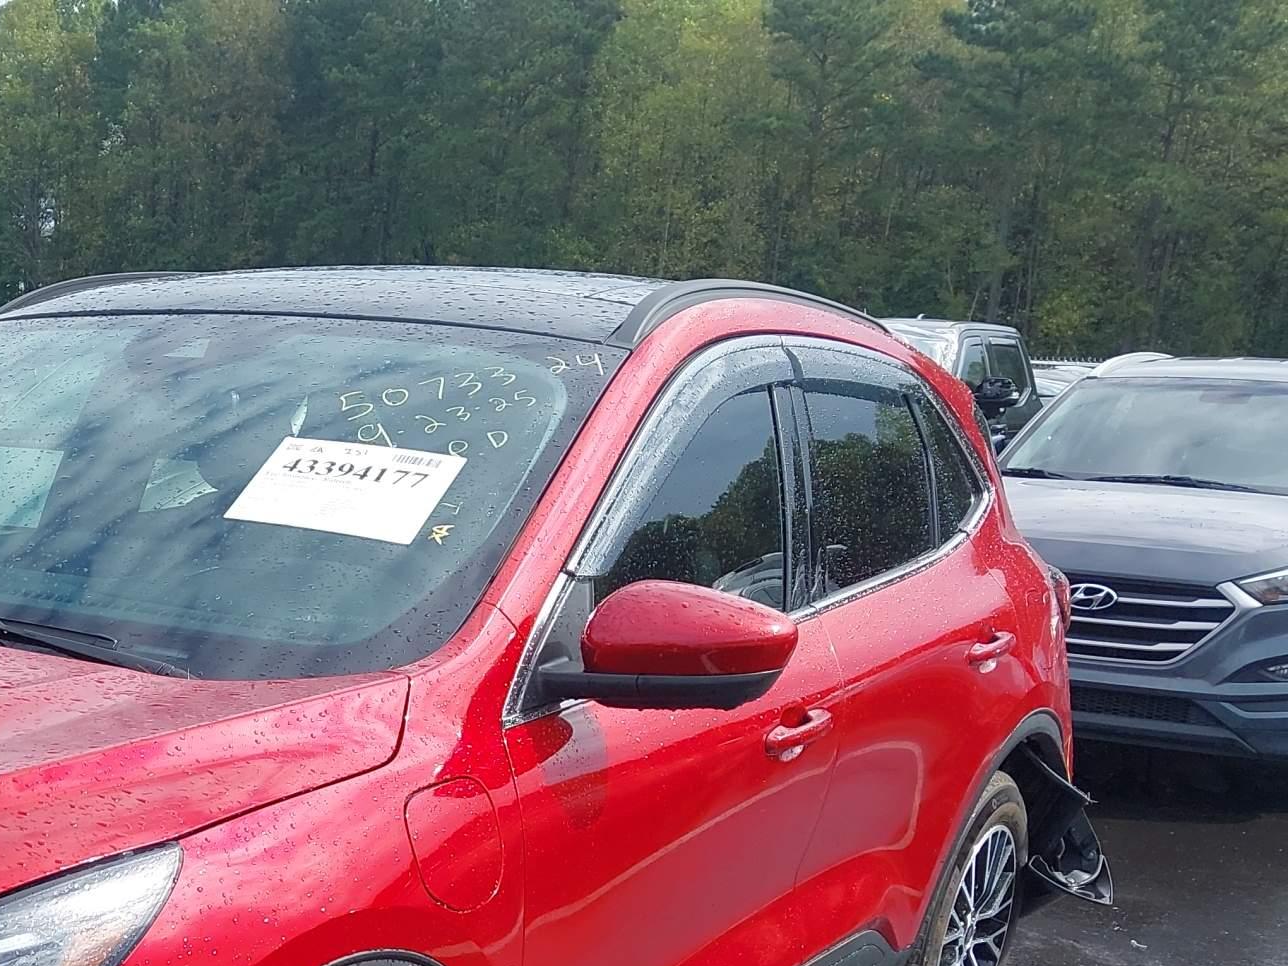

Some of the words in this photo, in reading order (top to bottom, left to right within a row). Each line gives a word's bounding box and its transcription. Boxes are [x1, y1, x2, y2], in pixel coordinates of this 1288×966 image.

[546, 352, 605, 376] 24
[339, 366, 516, 422] 50733
[282, 457, 429, 488] 43394177
